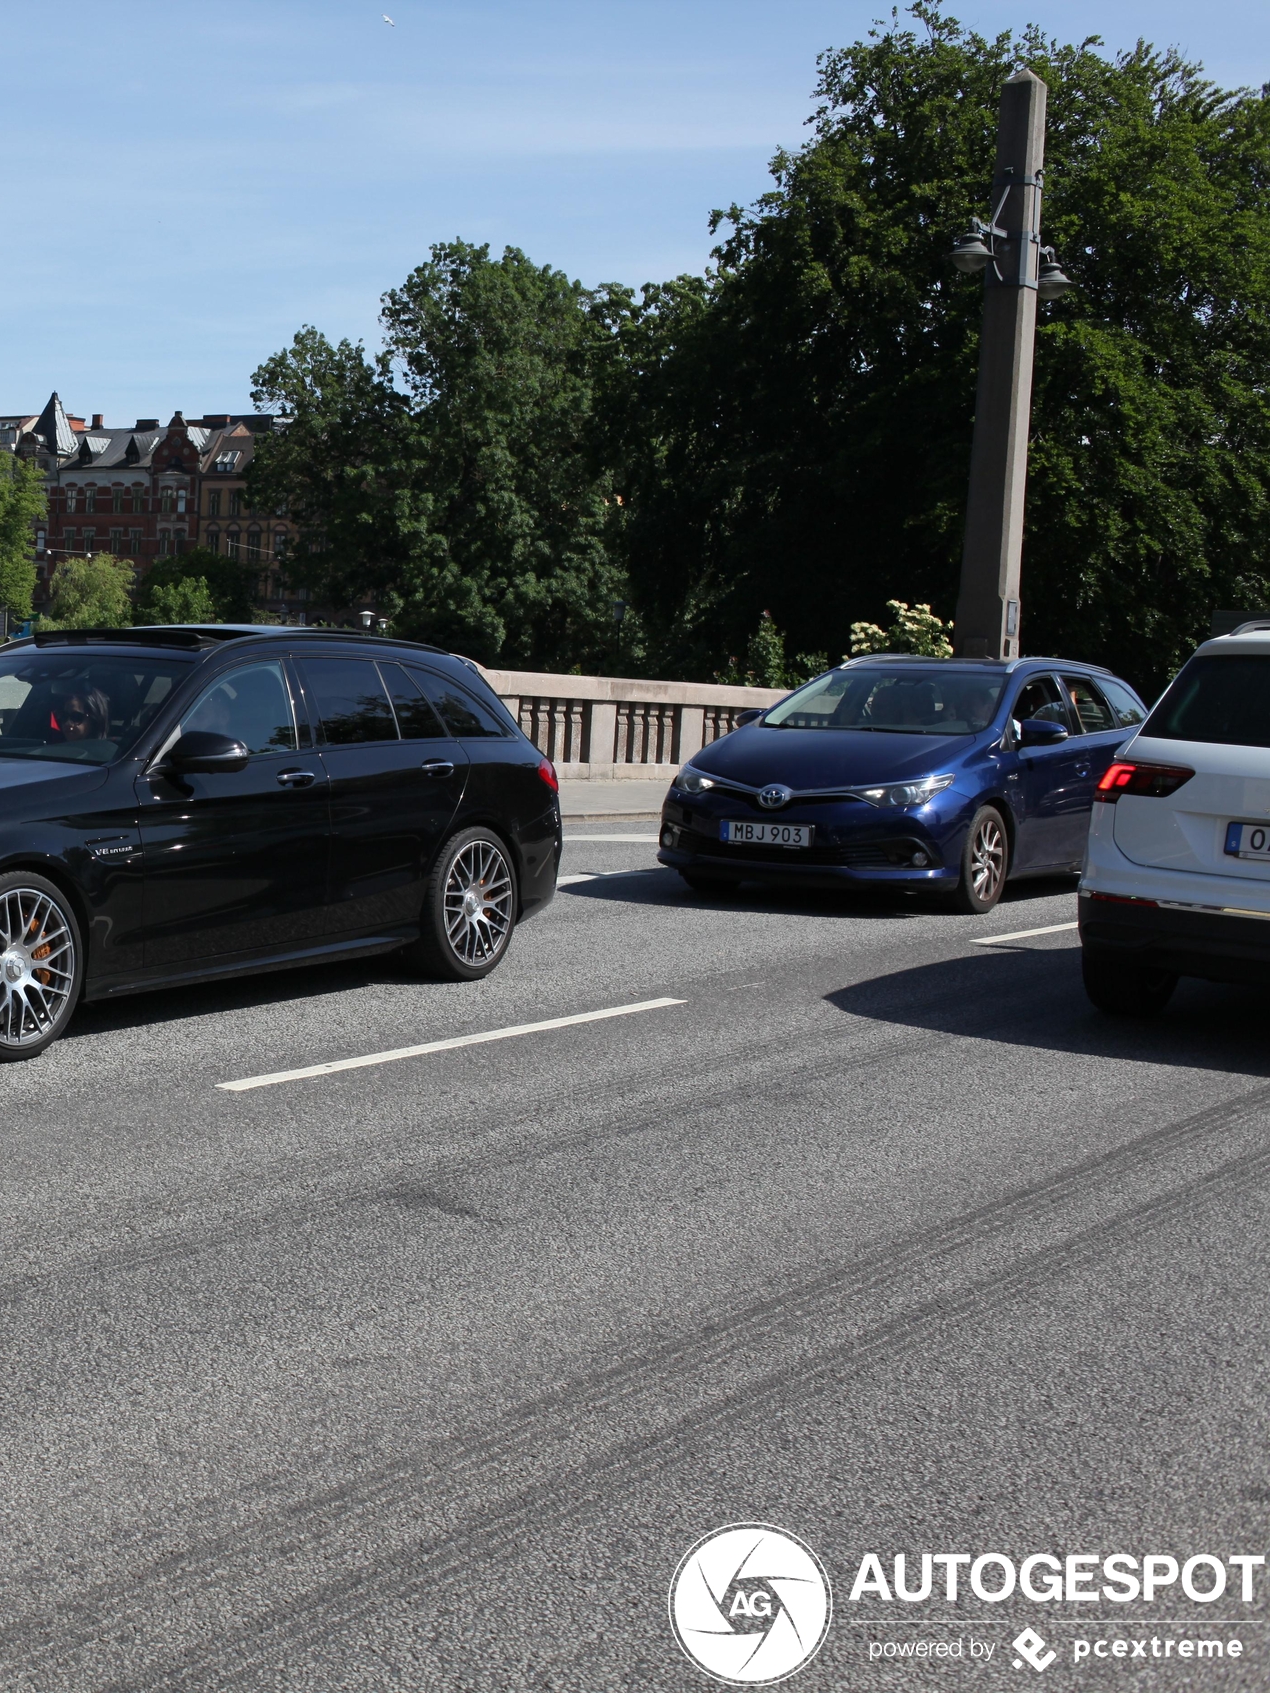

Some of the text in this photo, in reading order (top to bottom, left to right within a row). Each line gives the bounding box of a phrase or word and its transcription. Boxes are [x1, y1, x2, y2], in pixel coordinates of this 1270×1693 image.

[734, 823, 802, 844] MBJ 903
[1250, 828, 1270, 851] O
